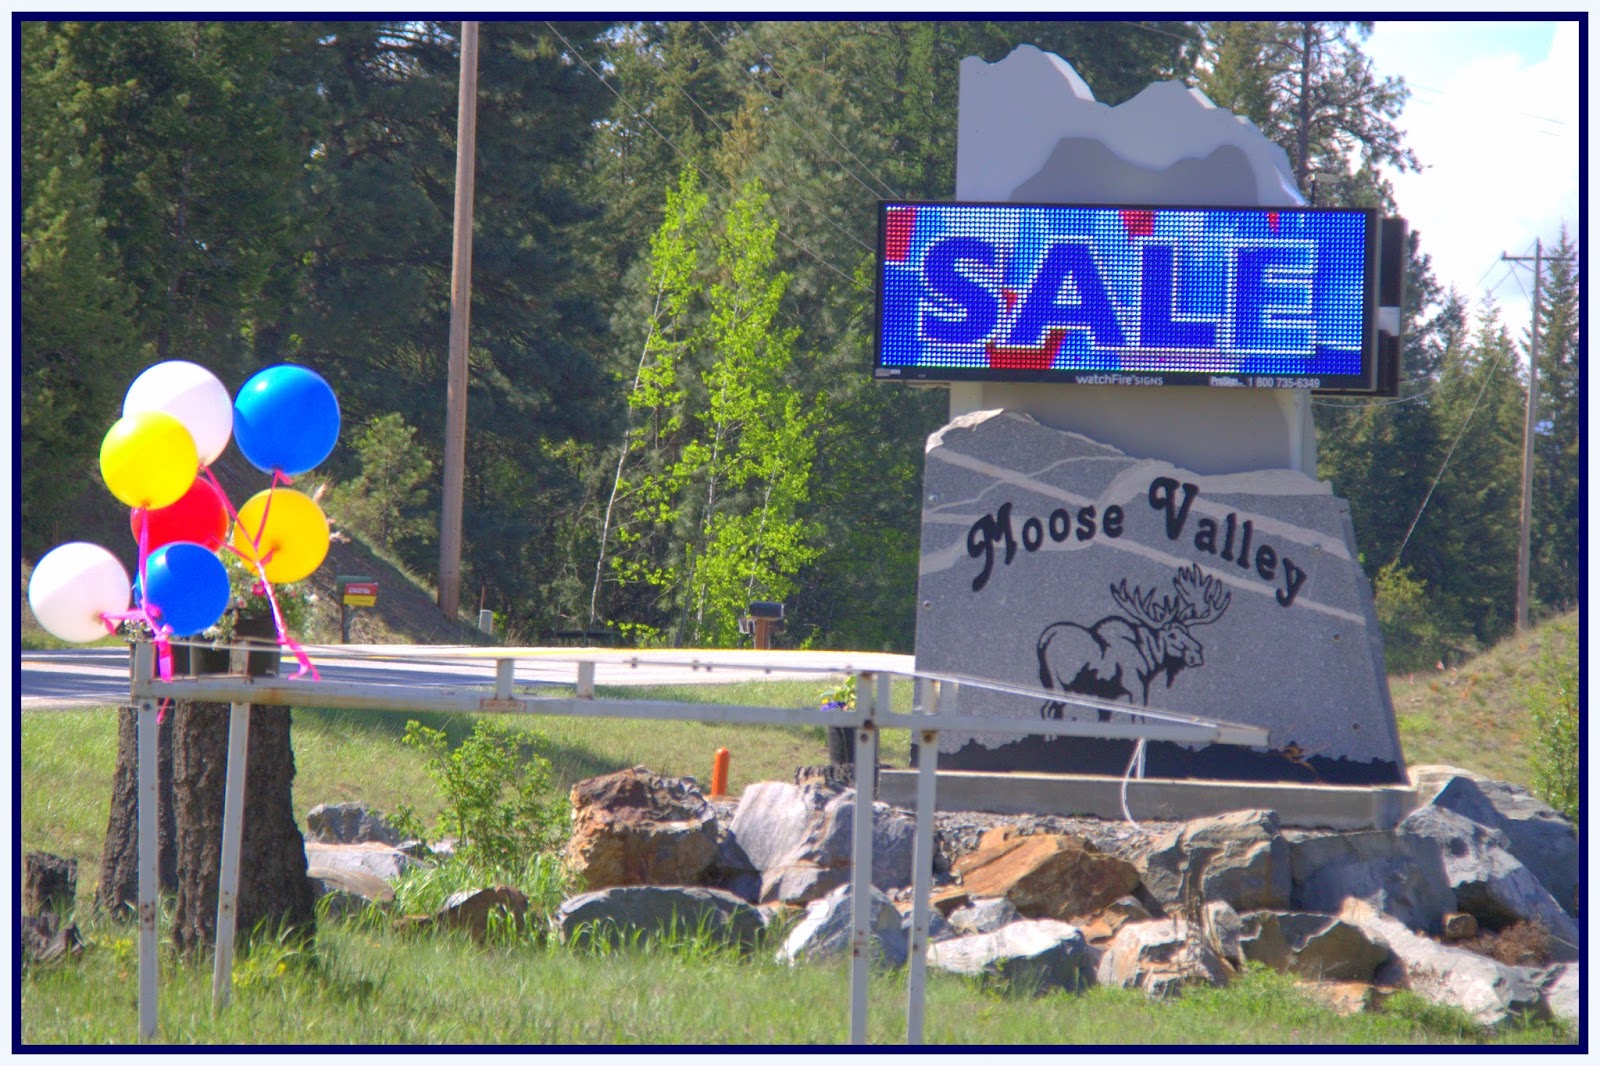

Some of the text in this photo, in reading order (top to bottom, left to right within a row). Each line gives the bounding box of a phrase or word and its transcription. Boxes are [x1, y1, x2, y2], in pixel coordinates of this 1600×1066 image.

[918, 234, 1316, 354] SALE
[1135, 376, 1164, 386] SIGNS
[1248, 377, 1253, 387] 1
[1256, 377, 1274, 388] 800
[1277, 377, 1320, 388] 735-6349
[966, 476, 1308, 608] Moose Valley
